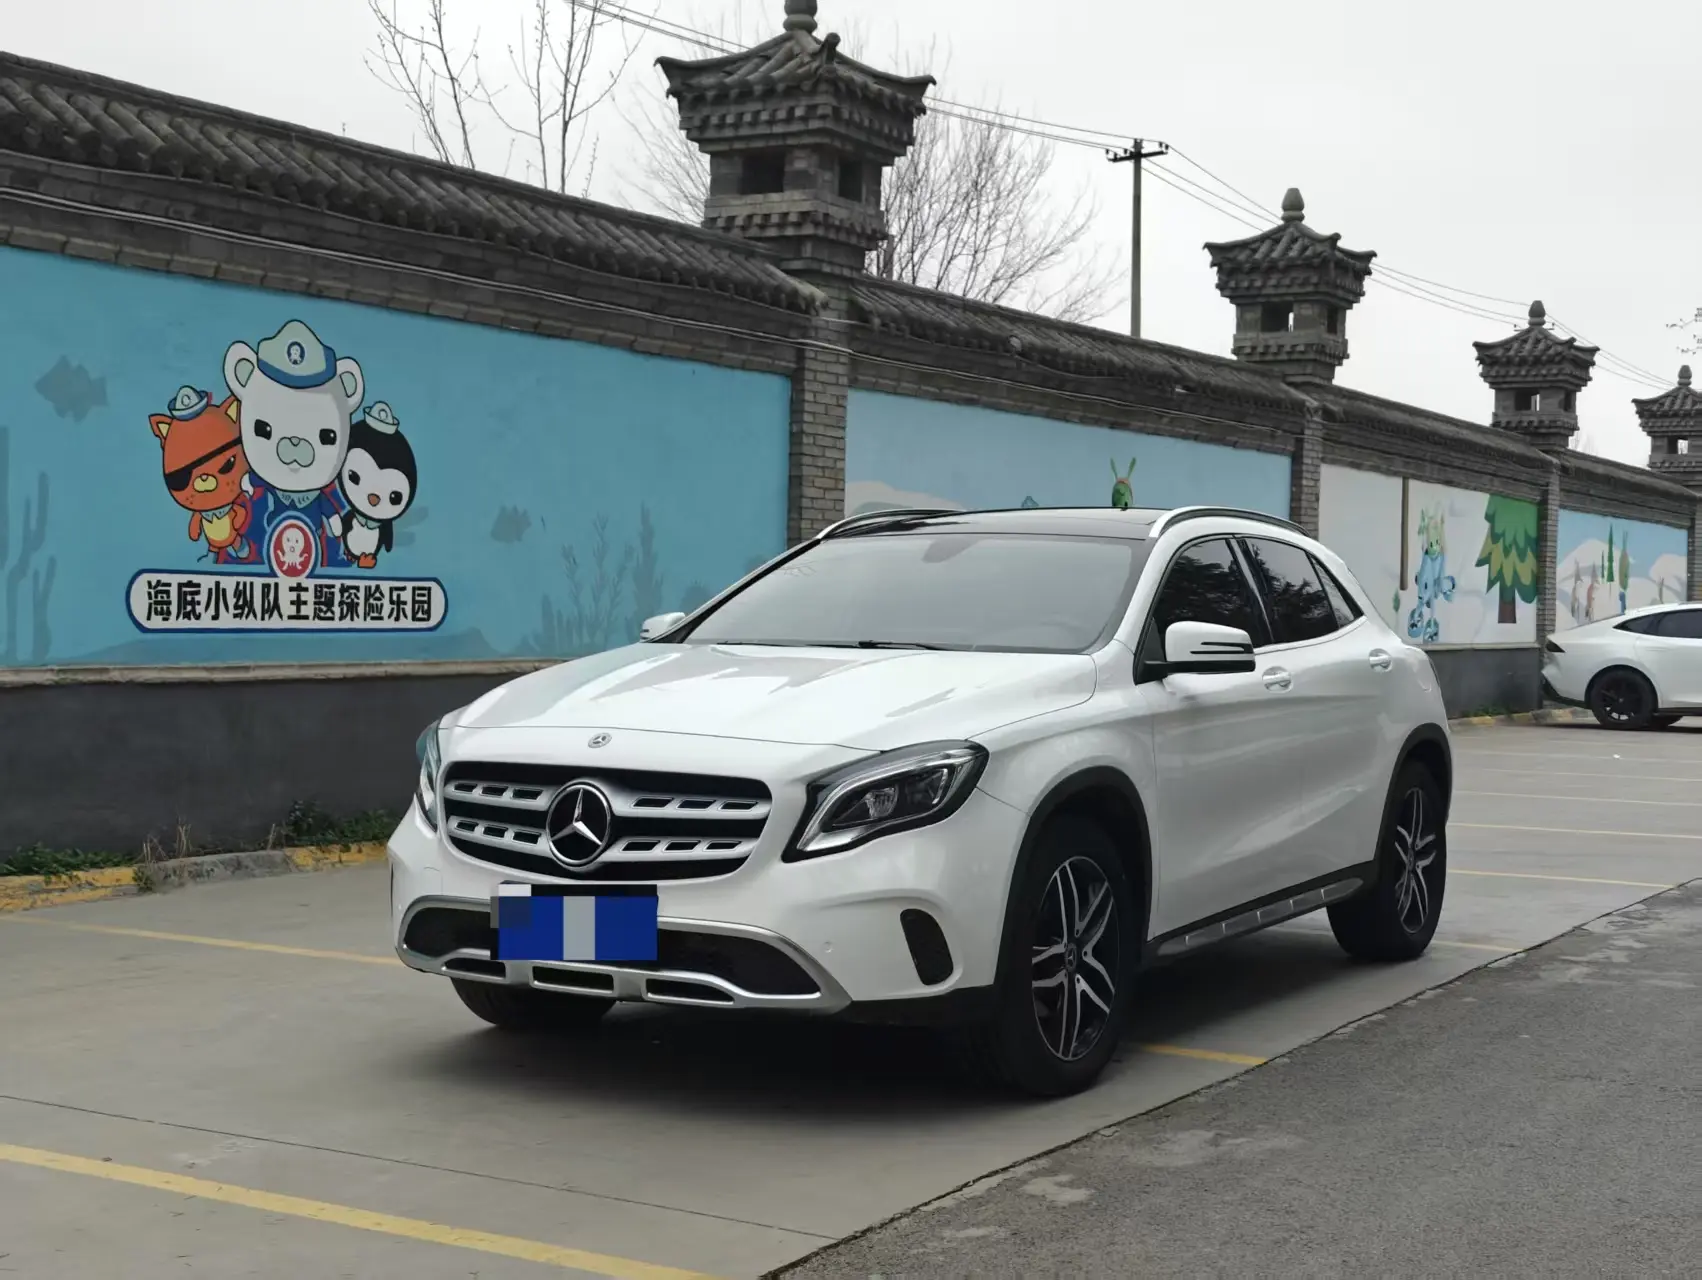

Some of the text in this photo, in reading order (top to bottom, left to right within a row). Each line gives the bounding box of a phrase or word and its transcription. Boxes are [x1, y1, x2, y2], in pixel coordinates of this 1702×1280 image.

[146, 579, 432, 622] 海底小纵队主题探险乐园
